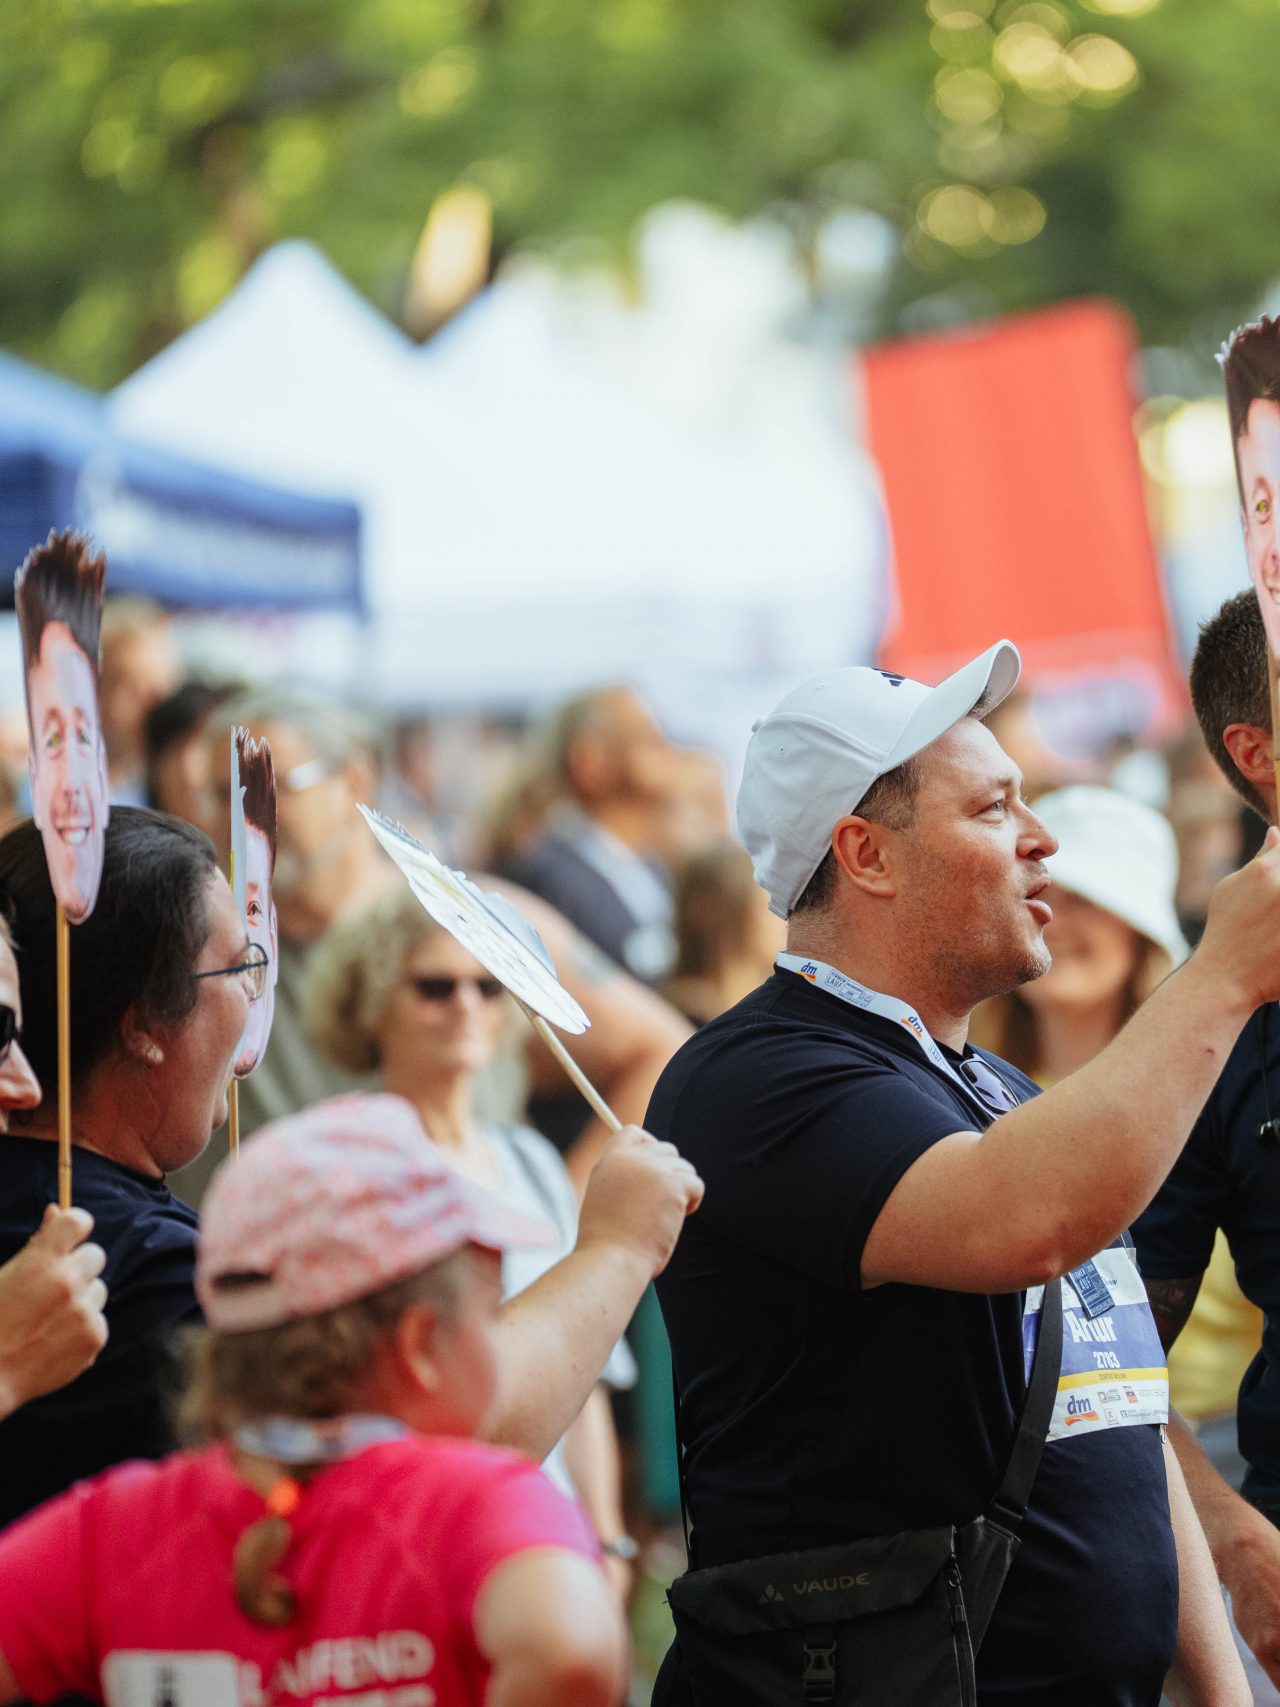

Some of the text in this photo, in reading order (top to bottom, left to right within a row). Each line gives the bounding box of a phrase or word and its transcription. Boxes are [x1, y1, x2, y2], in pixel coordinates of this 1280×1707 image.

[800, 961, 818, 976] dm
[830, 971, 846, 983] FIRMEN
[826, 975, 844, 989] LAUF
[907, 1015, 923, 1034] dm
[1067, 1394, 1092, 1416] dm
[793, 1572, 870, 1595] VAUDE
